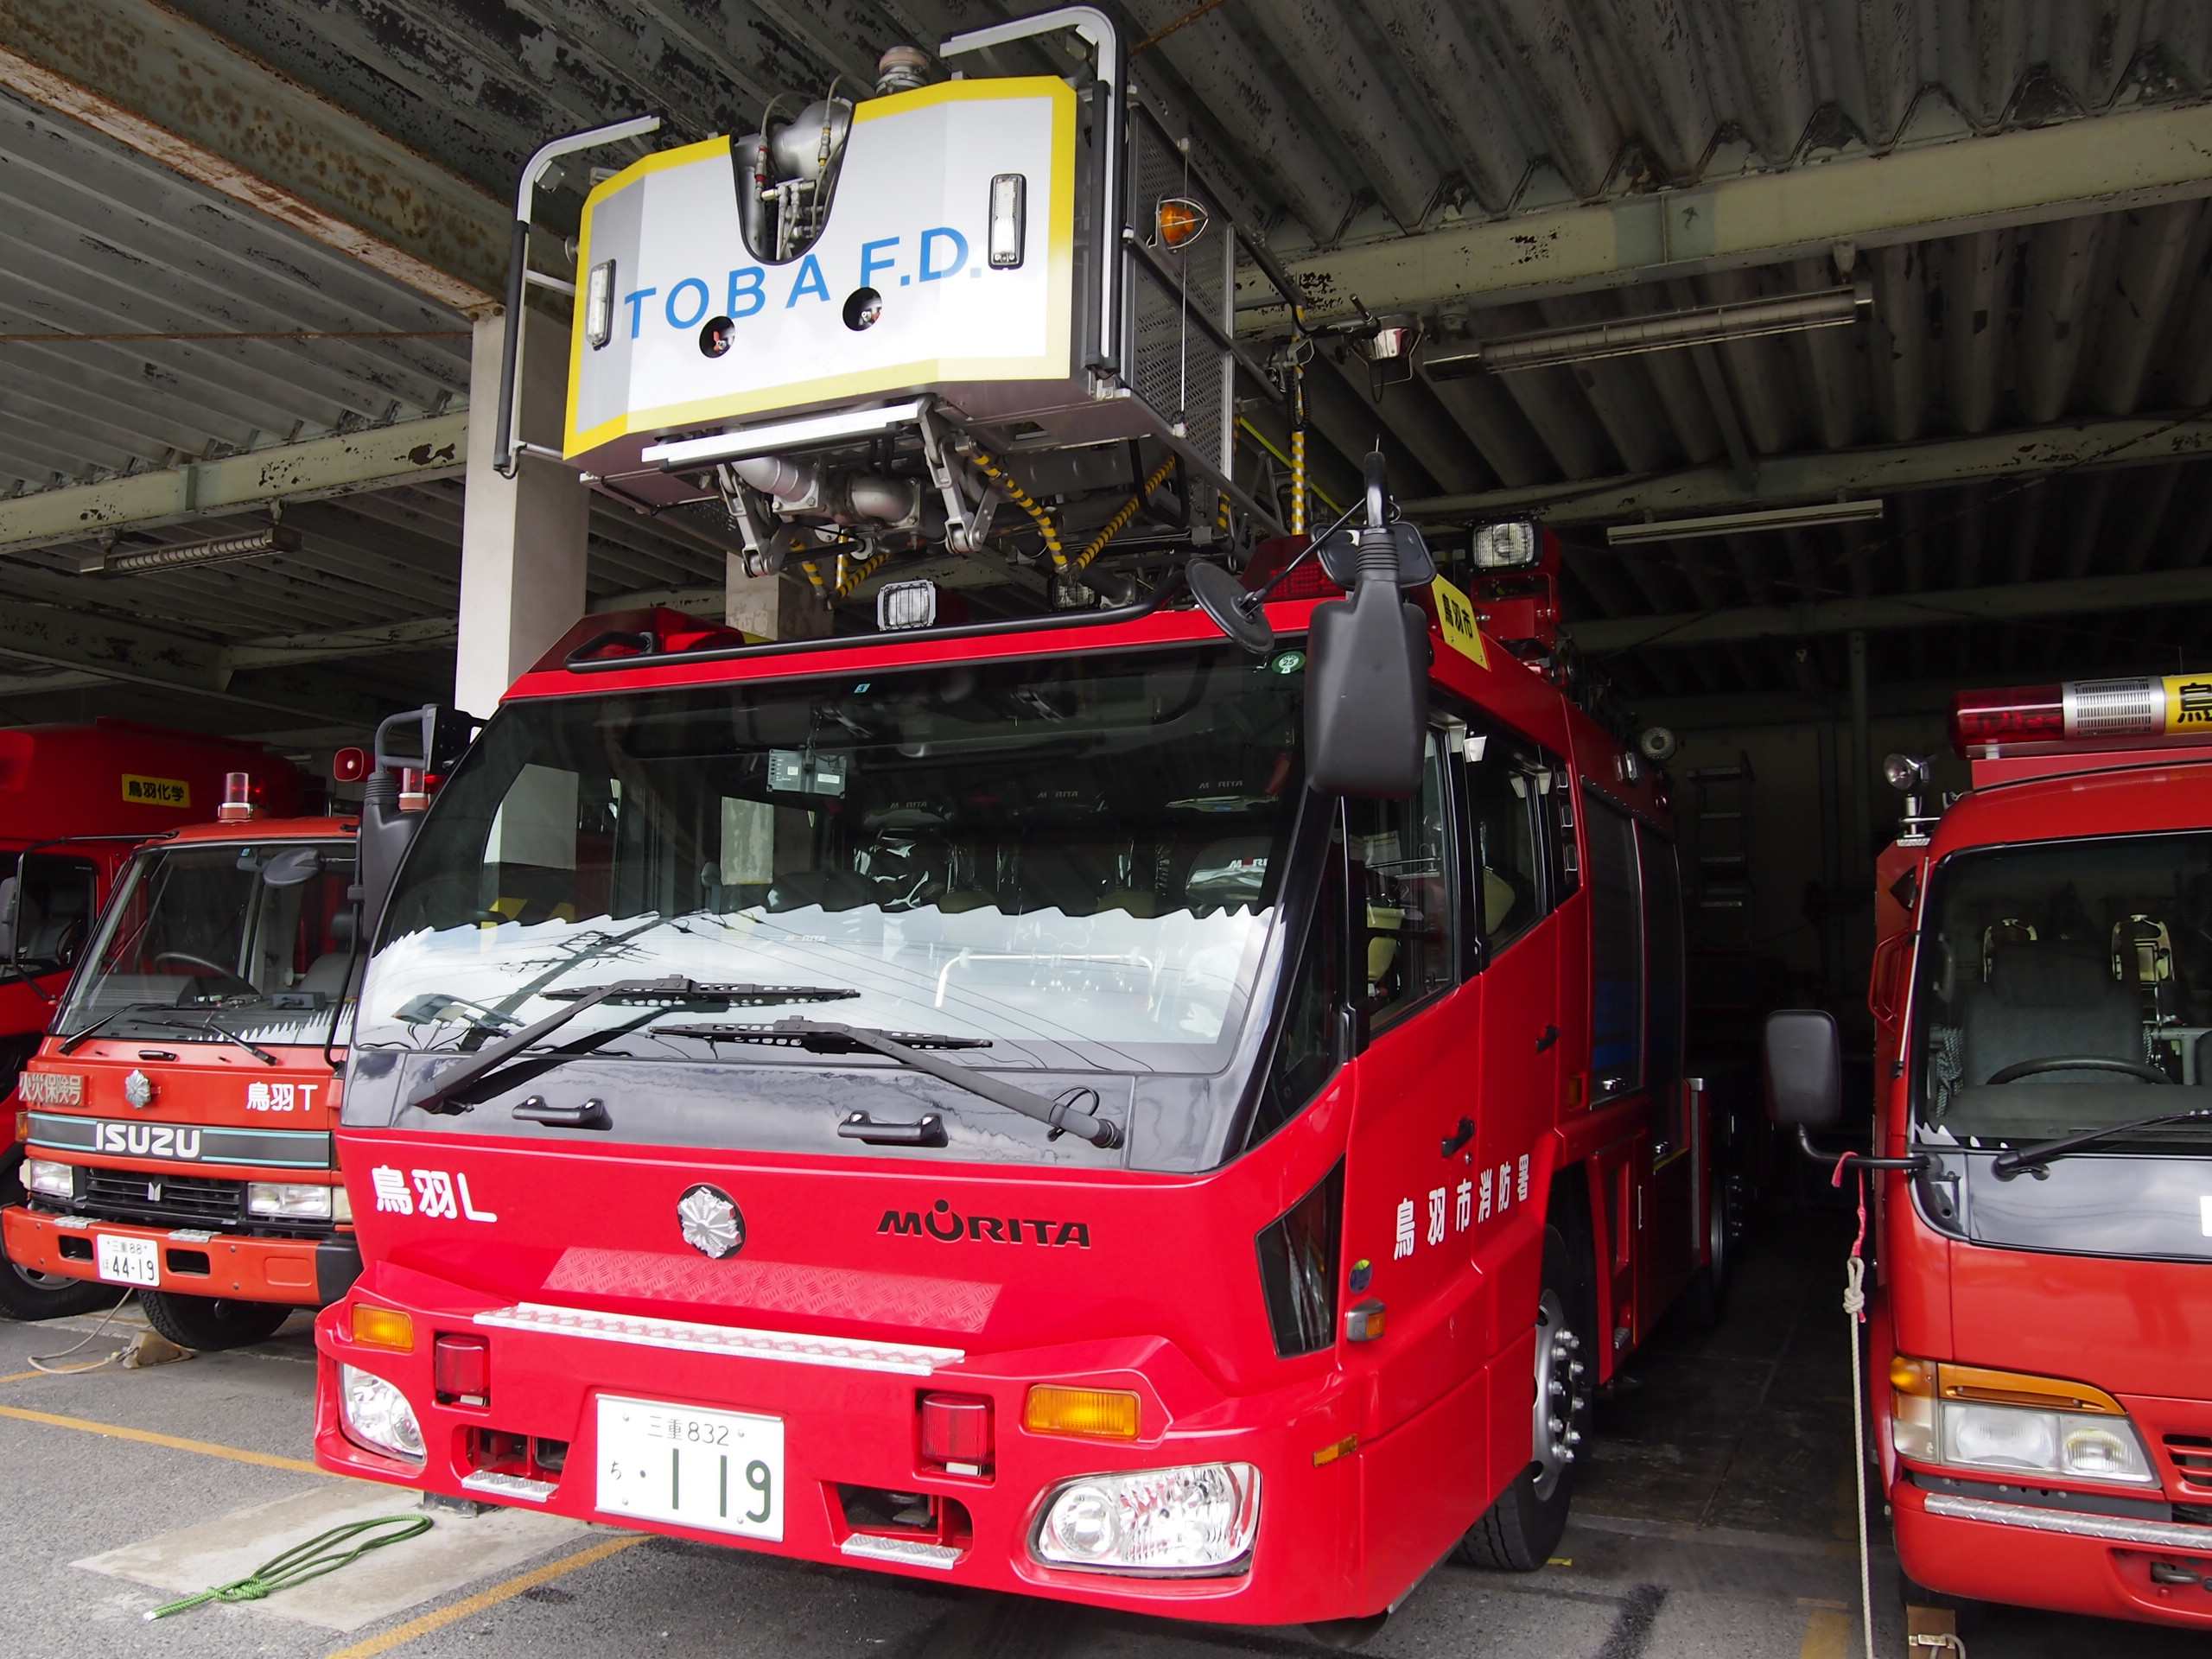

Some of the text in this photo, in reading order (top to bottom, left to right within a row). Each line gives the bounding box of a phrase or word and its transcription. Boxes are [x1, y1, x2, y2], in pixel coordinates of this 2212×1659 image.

[625, 226, 982, 339] TOBA F.D.
[1442, 593, 1473, 639] 鳥羽市
[129, 780, 184, 801] 鳥羽化学
[1037, 790, 1078, 798] MRITA
[1198, 779, 1243, 789] MRITA
[890, 800, 927, 810] MRITA
[19, 1073, 81, 1105] 火災保険号
[246, 1081, 318, 1111] 鳥羽T
[96, 1123, 200, 1158] ISUZU
[372, 1164, 498, 1223] 鳥羽L
[1394, 1154, 1529, 1261] 鳥羽市消防署
[876, 1198, 1090, 1249] MORITA
